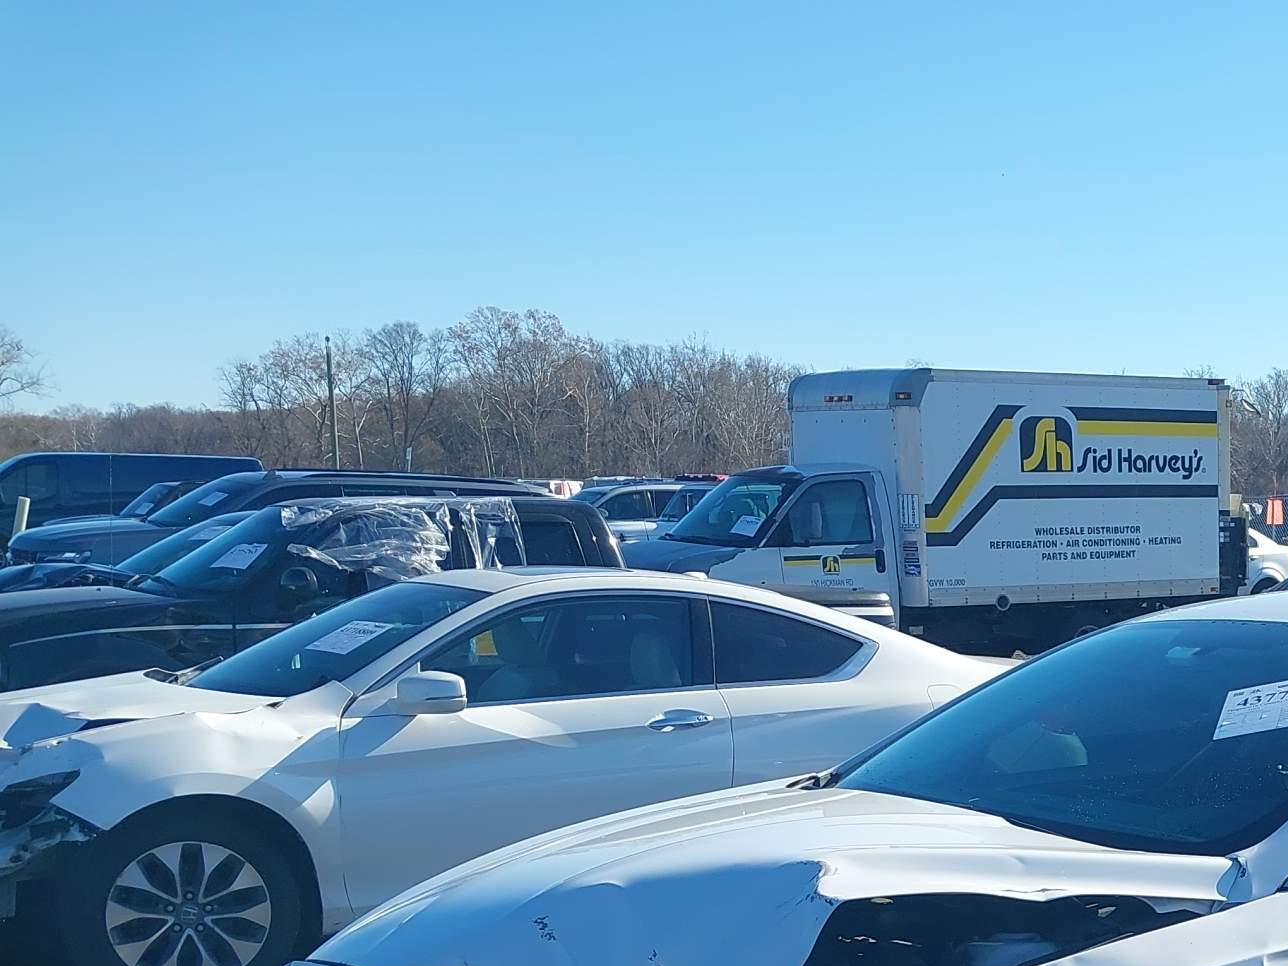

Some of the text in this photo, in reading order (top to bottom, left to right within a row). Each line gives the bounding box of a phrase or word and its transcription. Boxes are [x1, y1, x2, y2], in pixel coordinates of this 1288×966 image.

[1077, 447, 1203, 480] Sid Harvey's
[1034, 525, 1141, 537] WHOLESALE DISTRIBUTOR
[989, 536, 1182, 549] REFRIGERATION AIR CONDITIONING HEATING
[1041, 550, 1136, 561] PARTS AND EQUIPMENT
